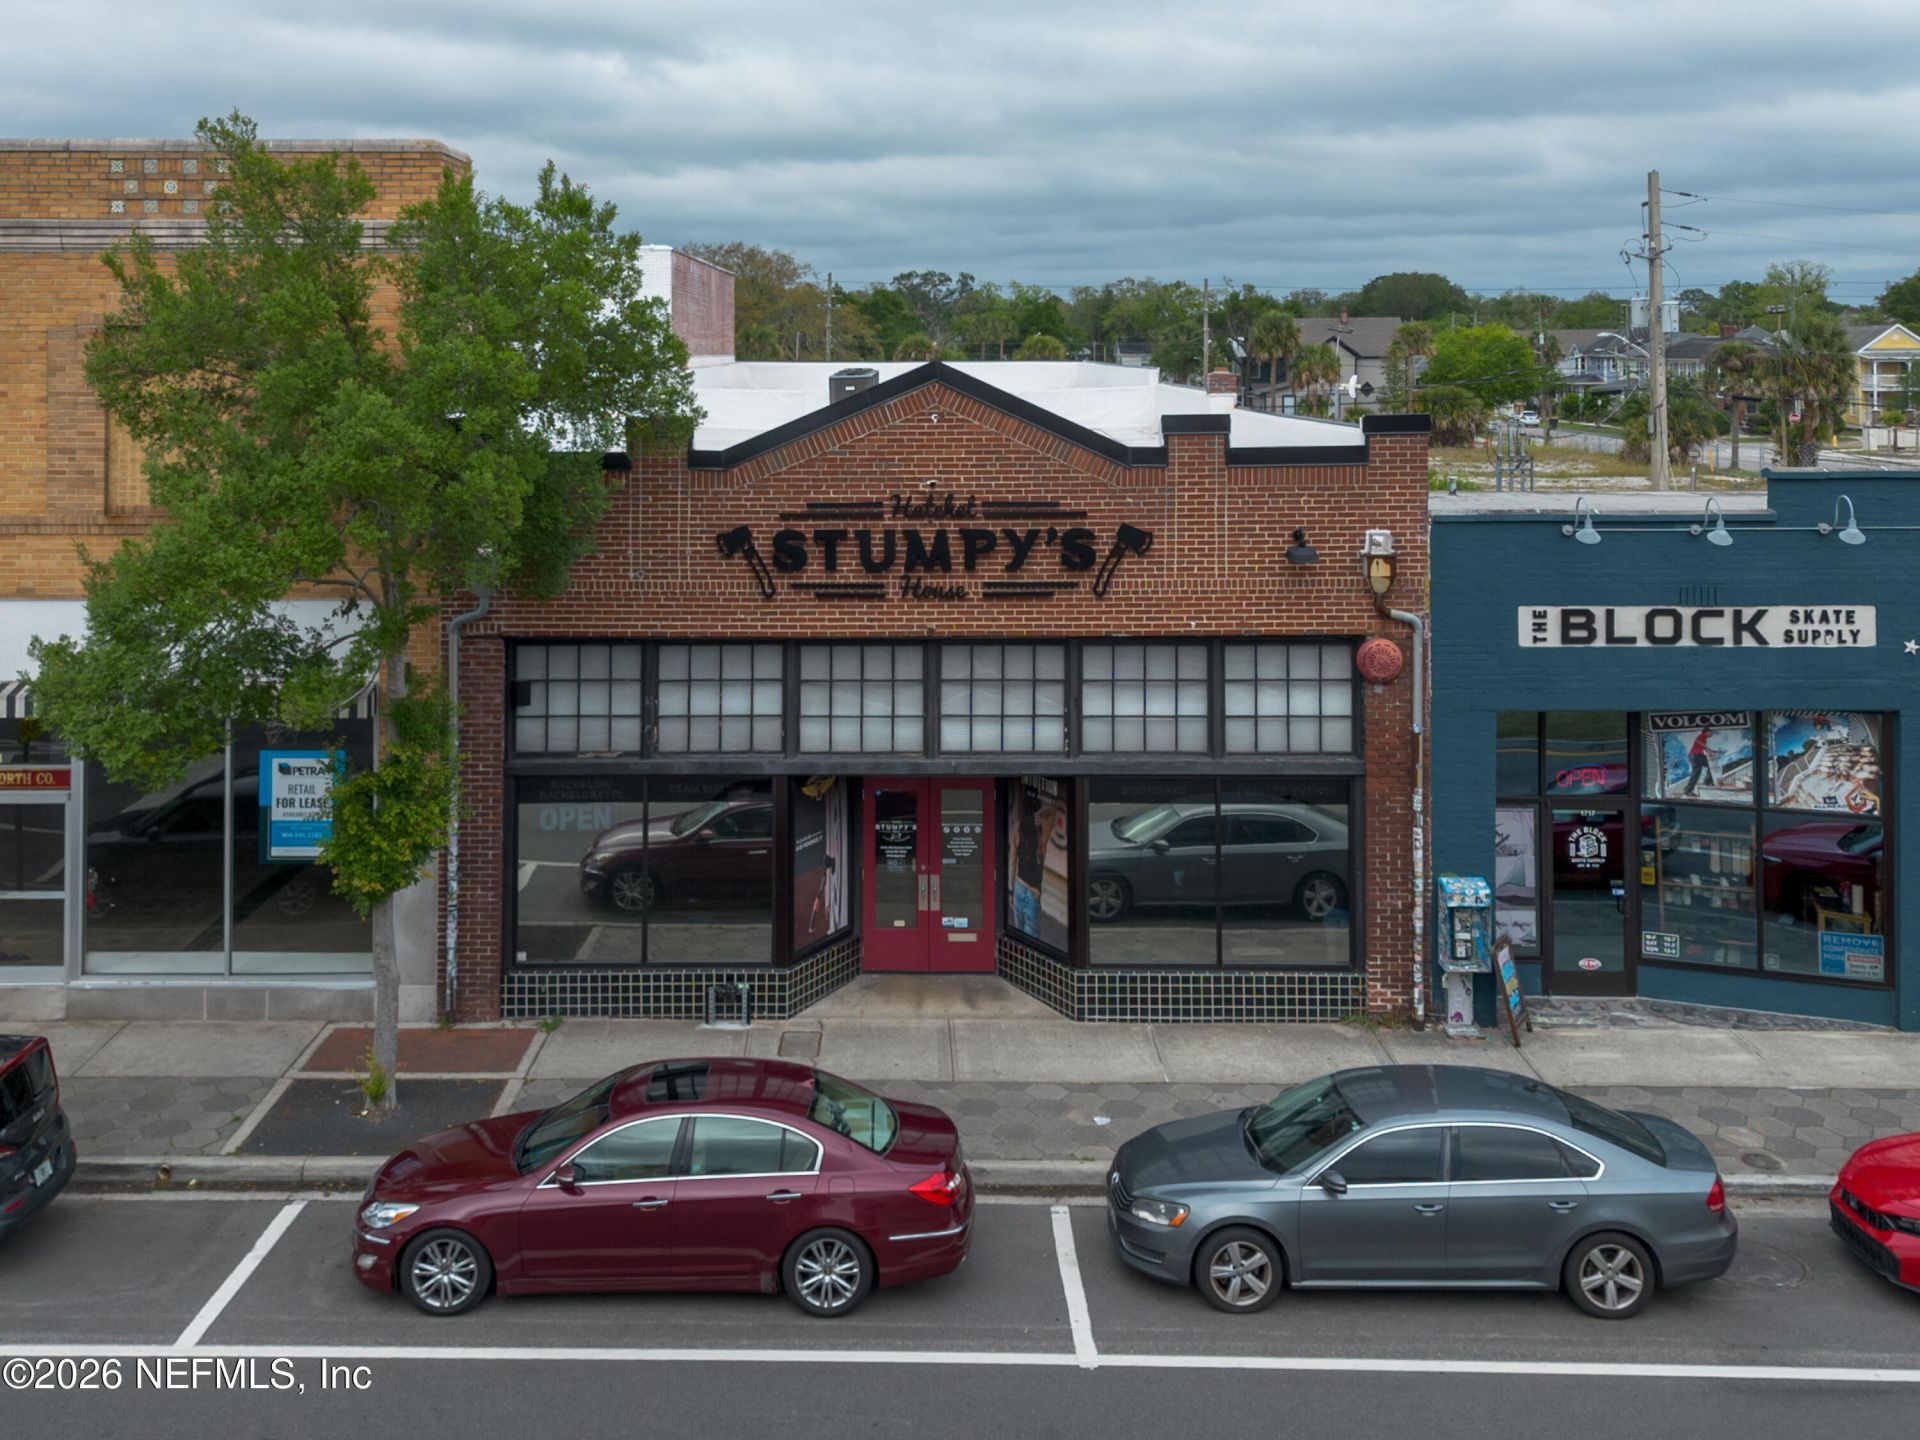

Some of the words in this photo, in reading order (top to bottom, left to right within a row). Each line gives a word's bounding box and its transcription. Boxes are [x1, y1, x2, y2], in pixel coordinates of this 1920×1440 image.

[890, 494, 978, 518] Hatchet
[772, 526, 1097, 573] STUMPY'S
[900, 574, 969, 598] House
[1789, 609, 1856, 625] SKATE
[1532, 609, 1547, 643] THE
[1560, 608, 1770, 646] BLOCK
[1783, 629, 1861, 645] SUPPLY
[1652, 713, 1746, 728] VOLCOM
[36, 772, 56, 785] CO.
[292, 766, 326, 776] PETRA
[1556, 767, 1605, 788] OPEN
[287, 784, 317, 795] RETAIL
[276, 797, 296, 809] FOR
[299, 797, 329, 809] LEASE
[539, 806, 612, 832] OPEN
[1568, 828, 1583, 842] THE
[1583, 826, 1607, 842] BLOCK
[1823, 935, 1880, 948] REMOVE
